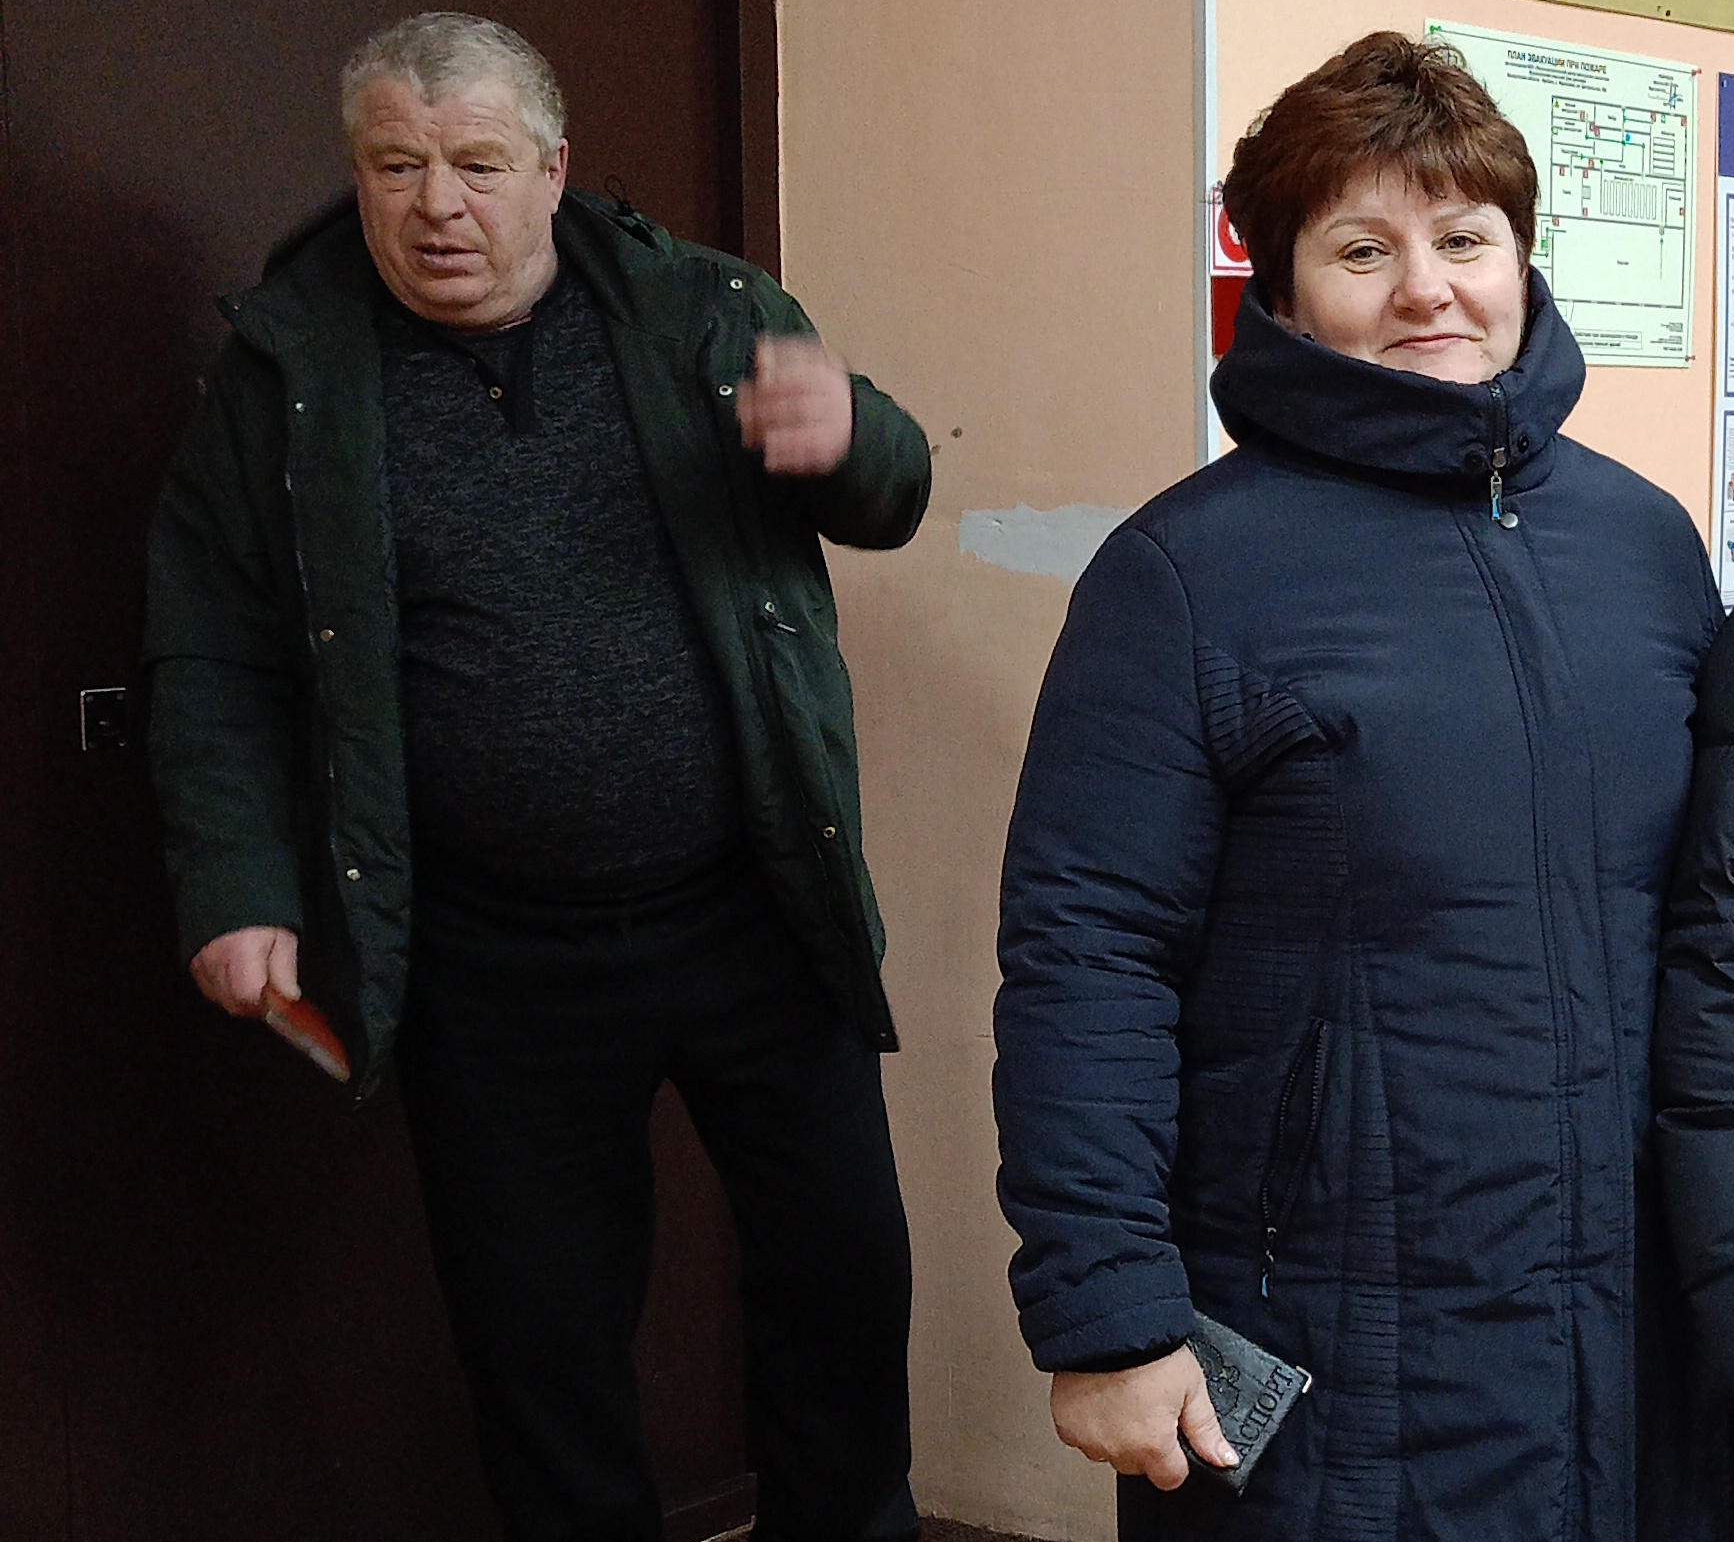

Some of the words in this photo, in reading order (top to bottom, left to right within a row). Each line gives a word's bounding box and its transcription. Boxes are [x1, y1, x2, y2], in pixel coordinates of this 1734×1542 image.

[1507, 50, 1526, 61] ПЛАН
[1566, 59, 1579, 69] ПРИ
[1229, 1364, 1293, 1463] АСПОРТ
